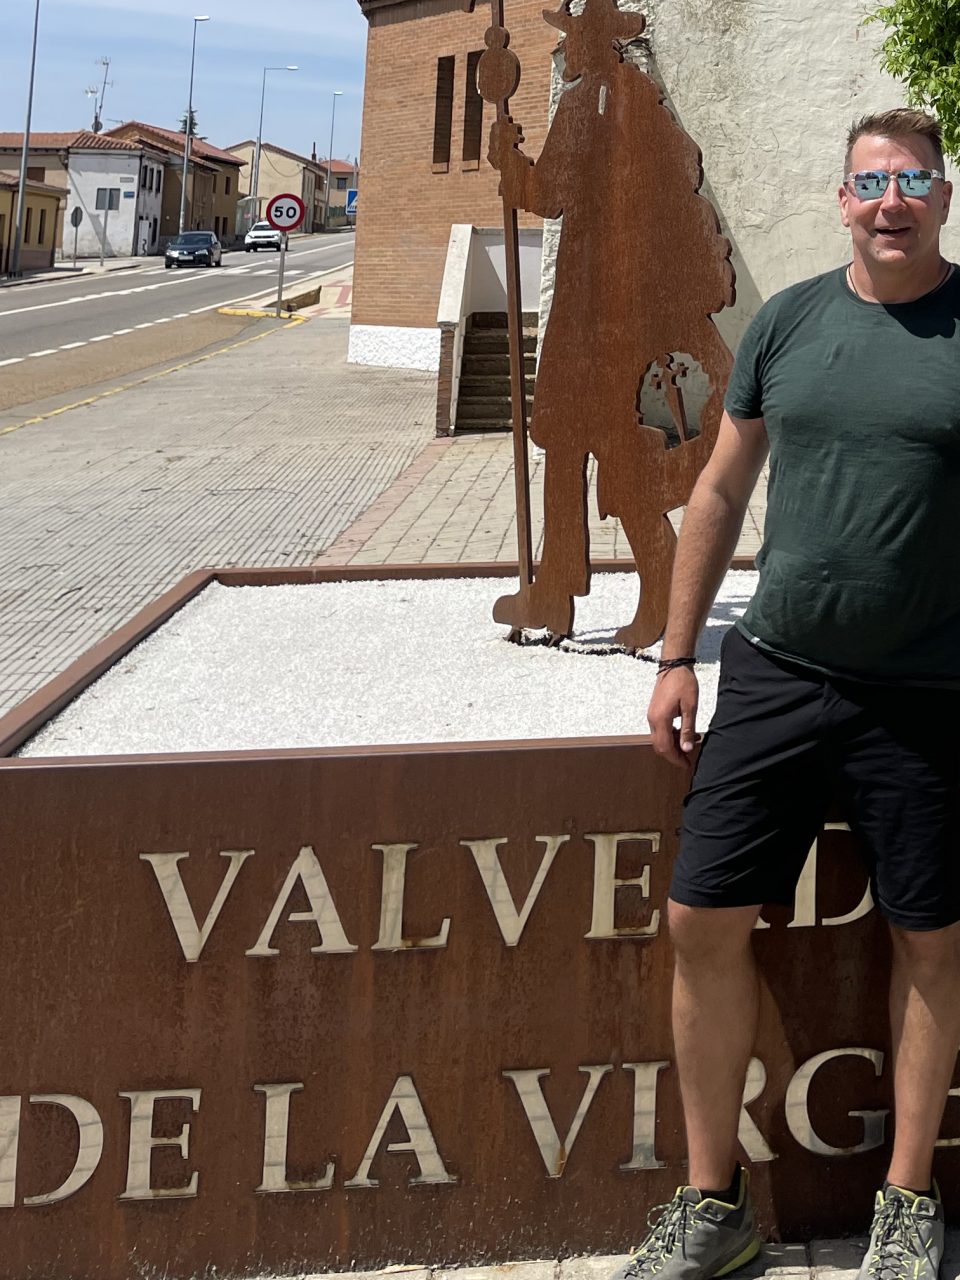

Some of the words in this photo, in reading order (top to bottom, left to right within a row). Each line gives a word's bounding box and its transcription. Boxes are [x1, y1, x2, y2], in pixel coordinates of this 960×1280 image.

[274, 206, 297, 219] 50
[0, 1088, 202, 1208] DE
[253, 1074, 458, 1195] LA
